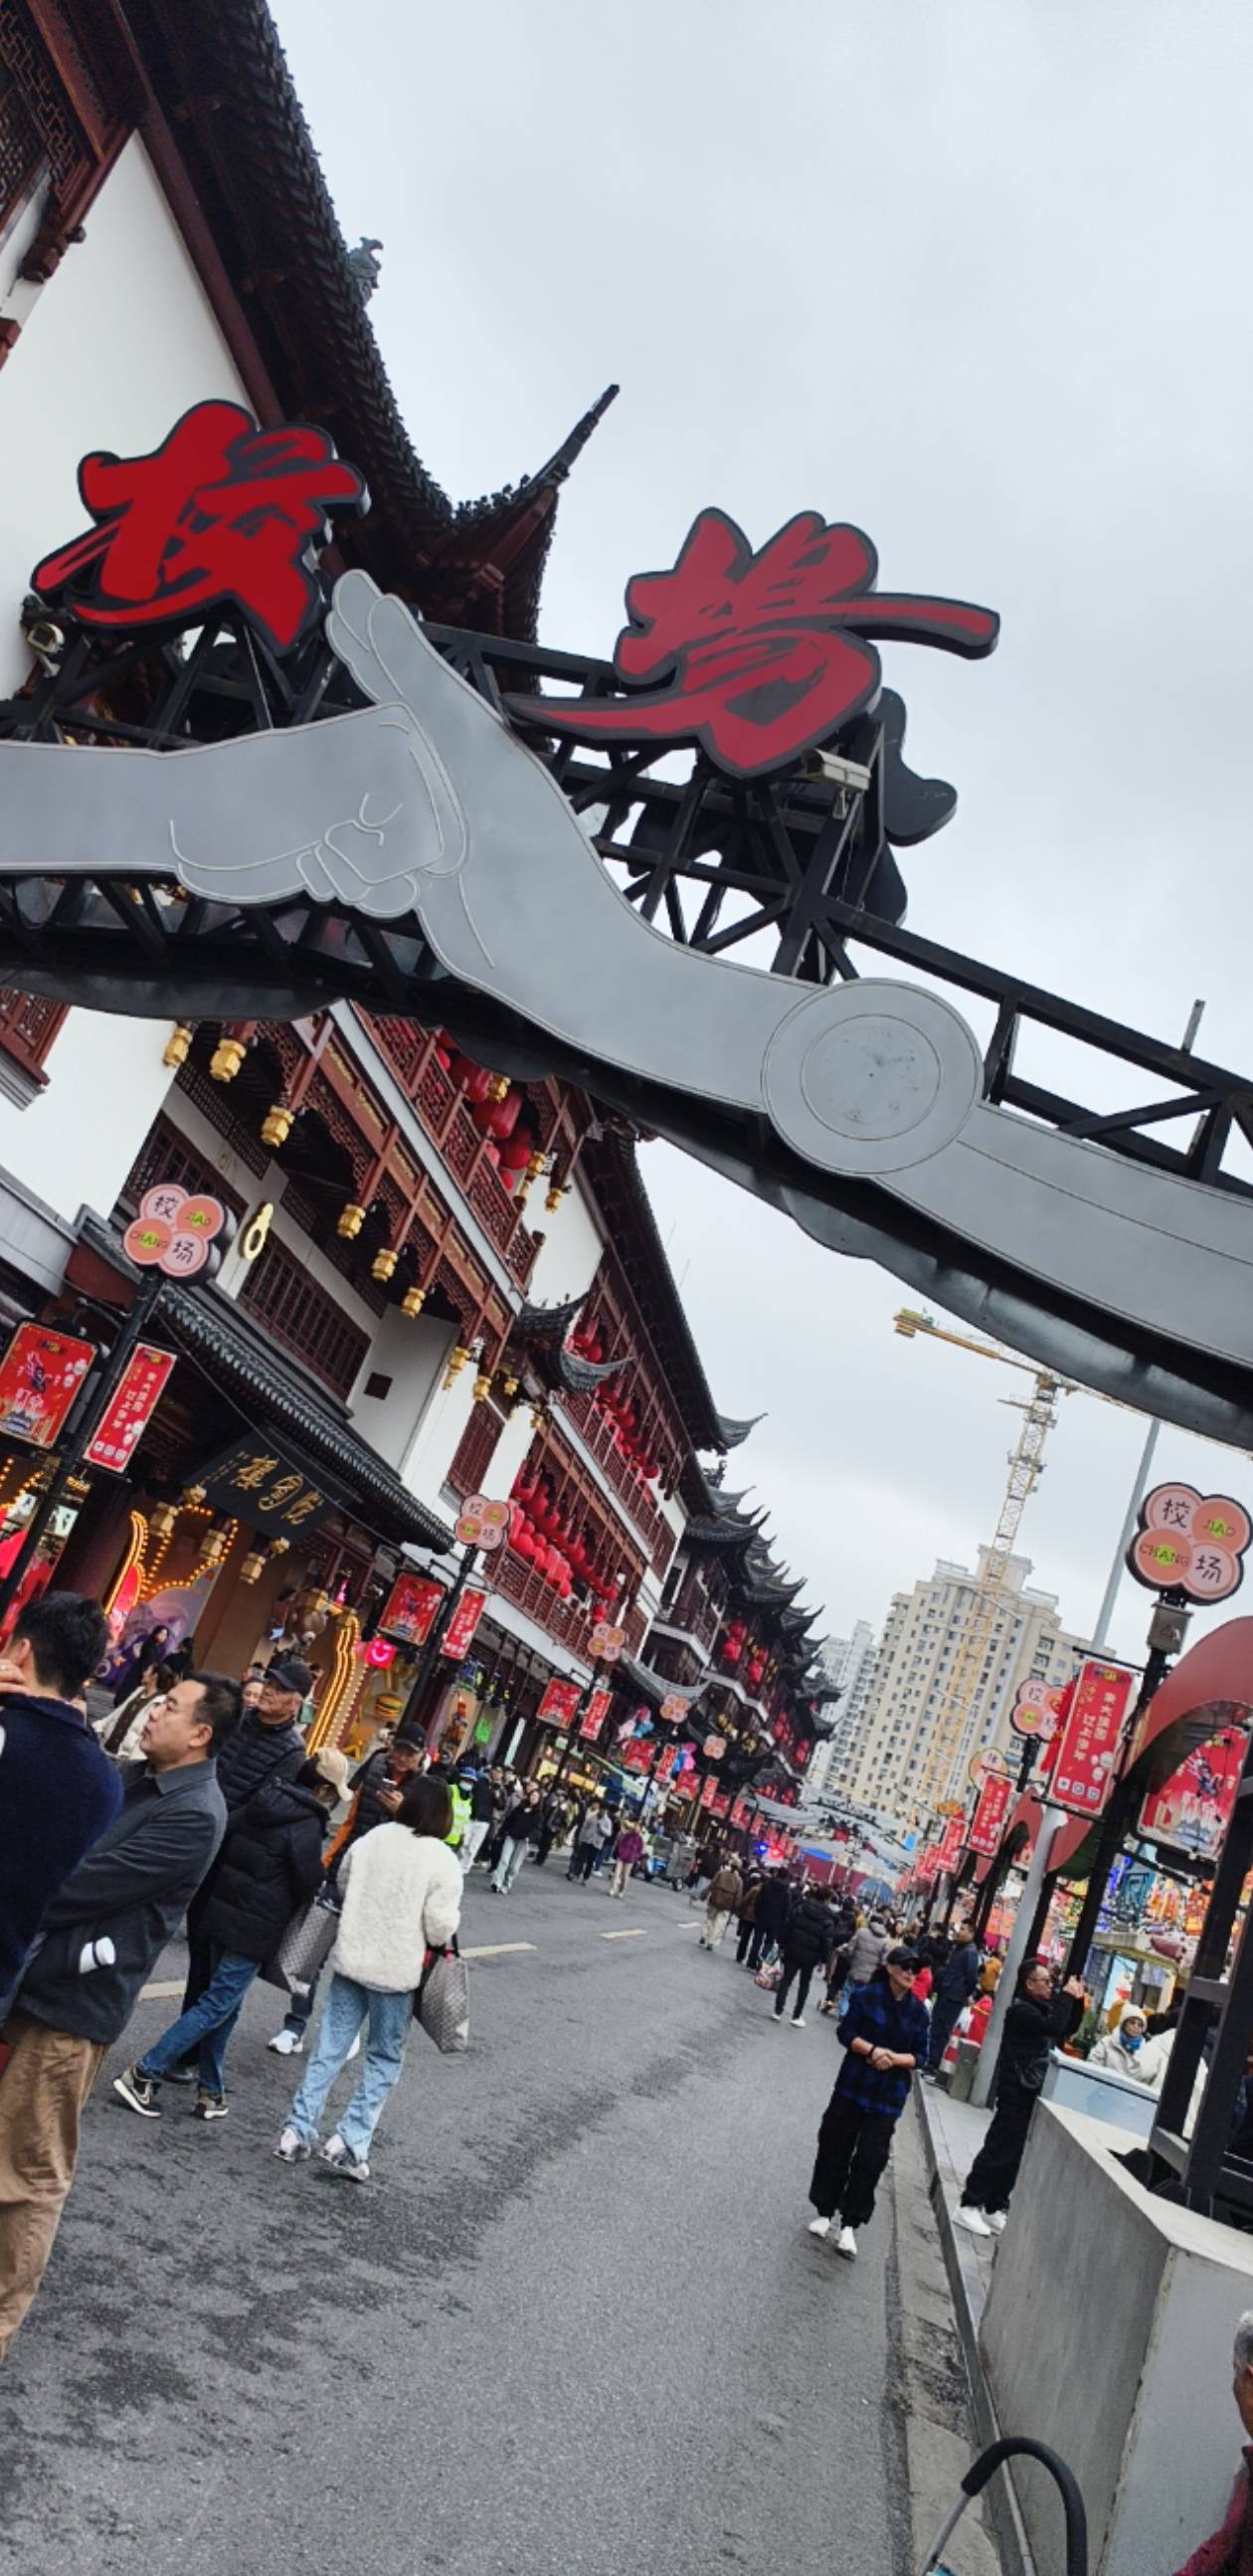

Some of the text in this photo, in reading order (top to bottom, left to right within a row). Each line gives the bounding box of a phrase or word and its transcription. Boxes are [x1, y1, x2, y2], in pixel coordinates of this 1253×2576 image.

[154, 1196, 178, 1218] 校
[173, 1240, 195, 1264] 场
[1163, 1499, 1190, 1528] 校
[1202, 1519, 1237, 1537] JIAO
[1139, 1543, 1190, 1567] CHANG
[1195, 1555, 1223, 1583] 场
